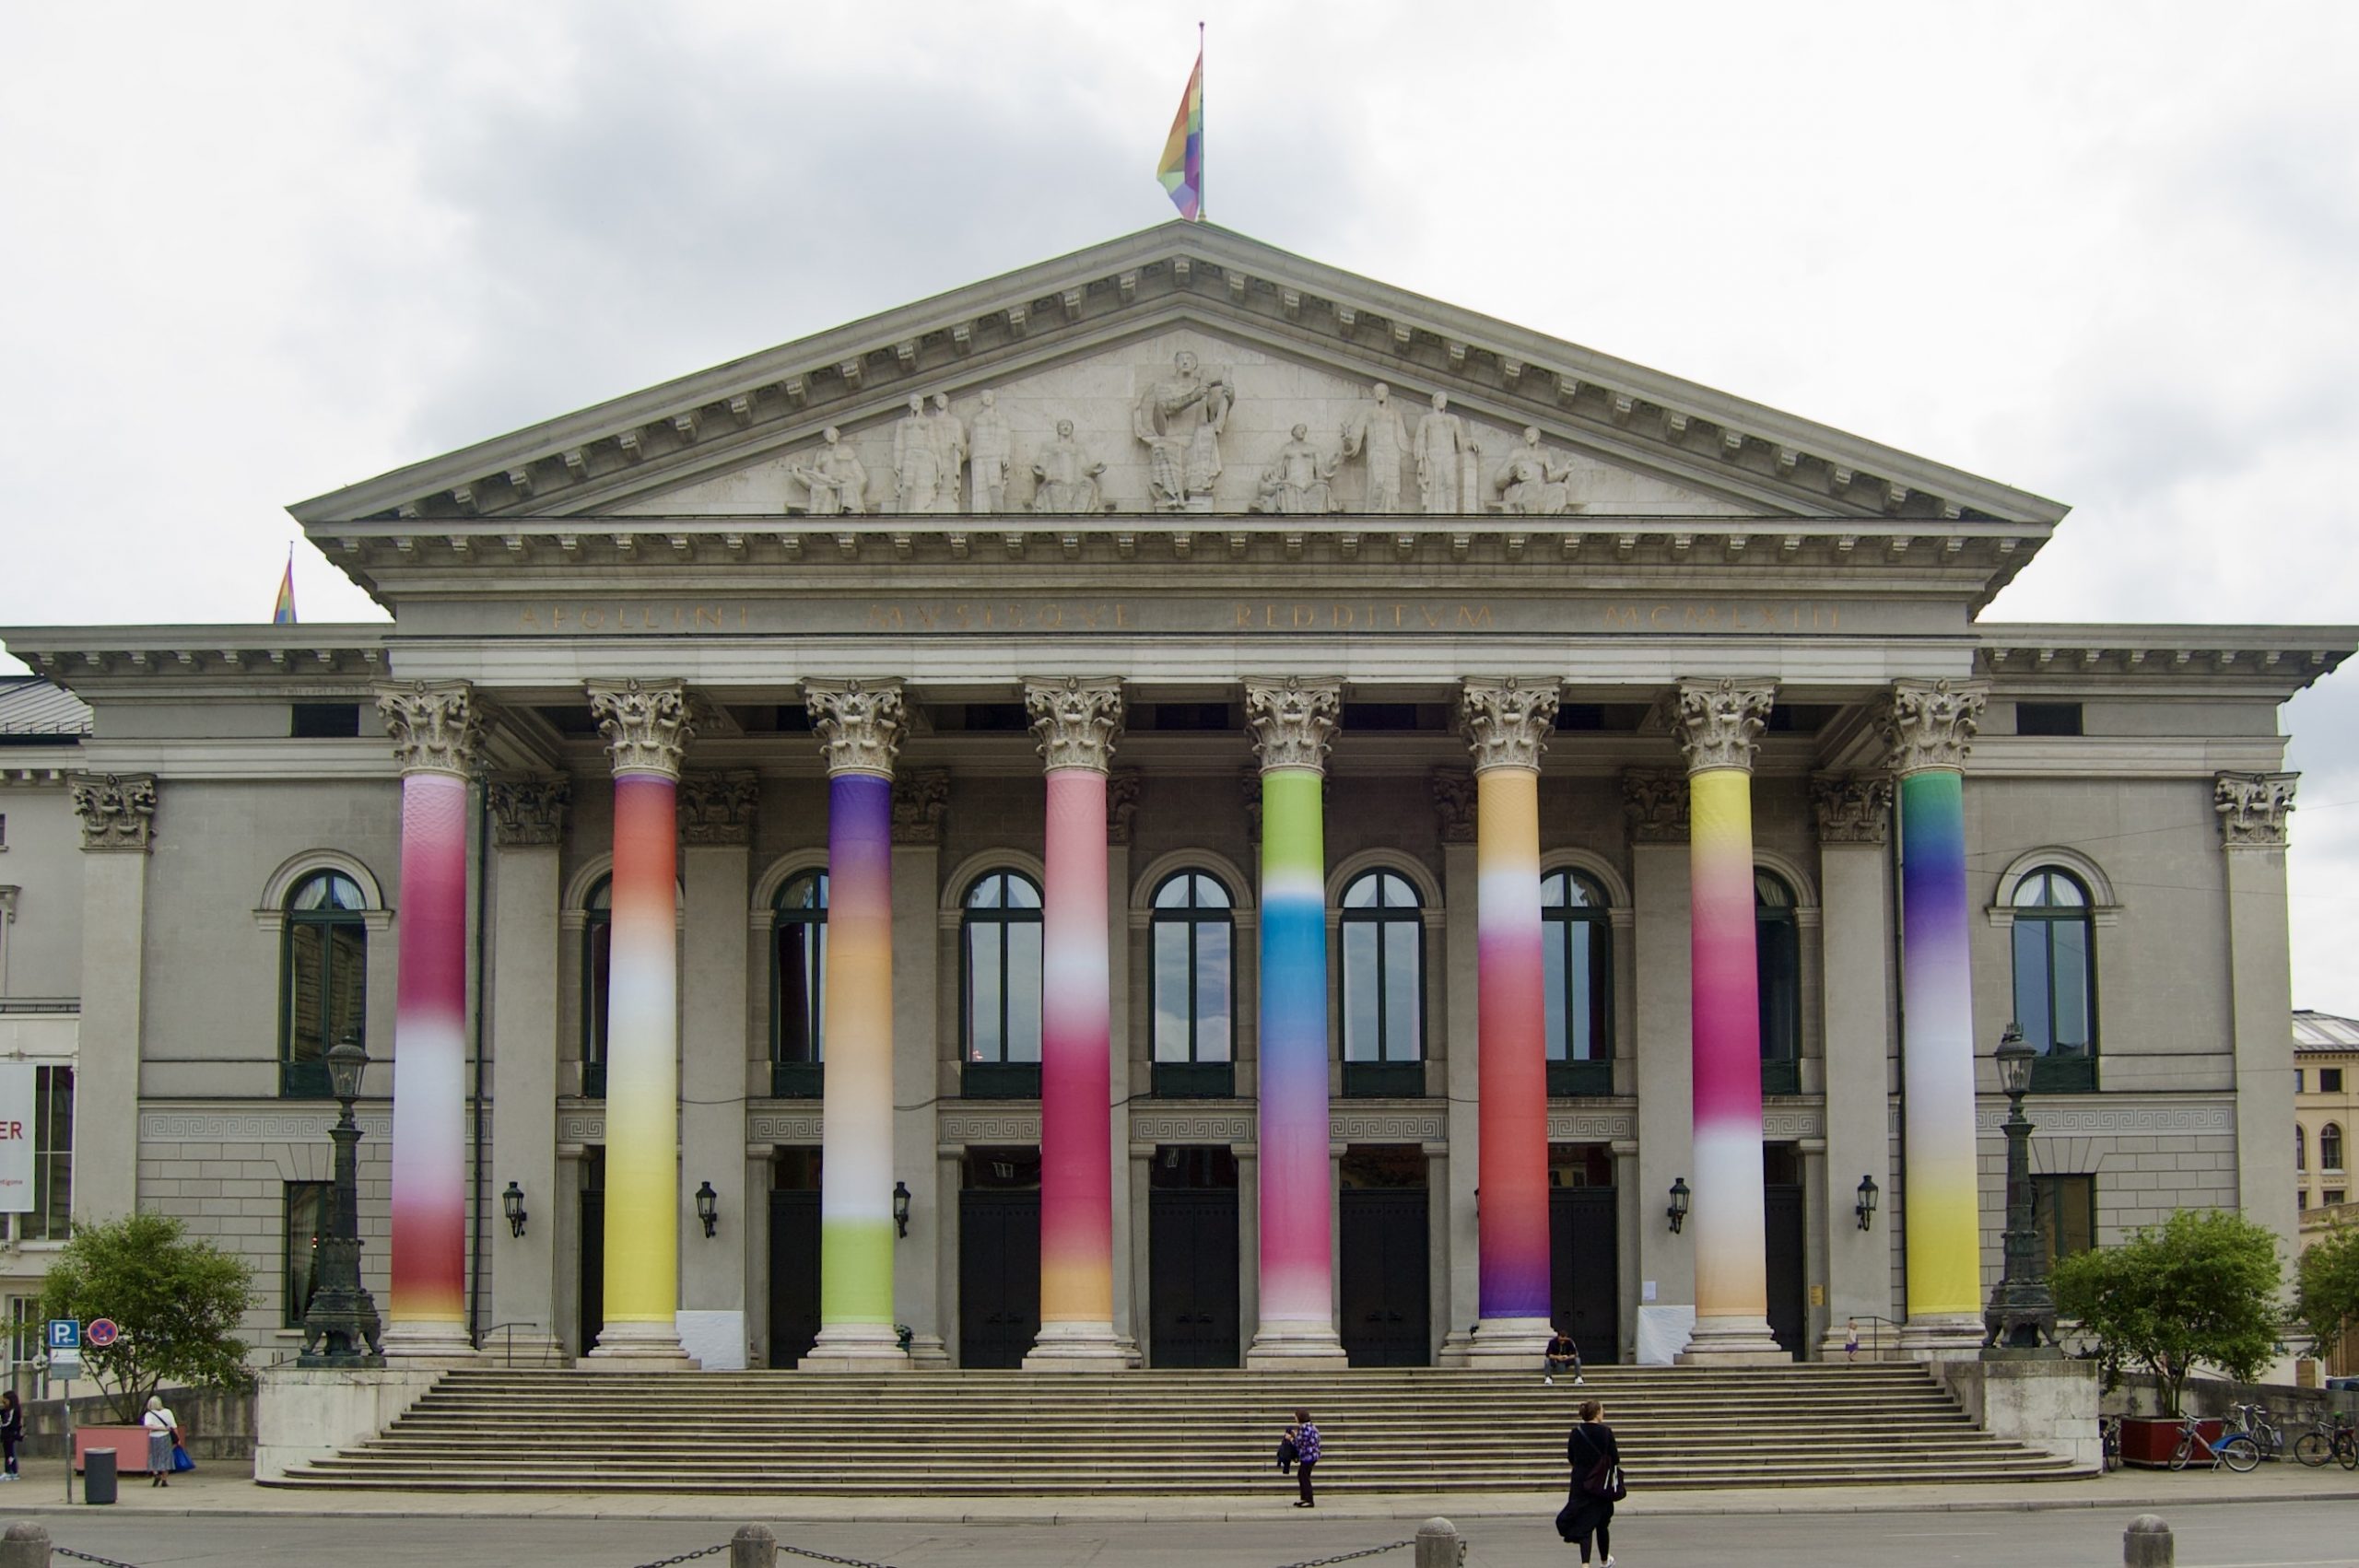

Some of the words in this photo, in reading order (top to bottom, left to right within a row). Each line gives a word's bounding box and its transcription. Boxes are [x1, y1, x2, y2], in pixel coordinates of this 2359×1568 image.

[519, 605, 748, 630] APOLLINI
[1233, 603, 1495, 628] REDDITVM
[1602, 603, 1841, 629] MCMLXIII
[54, 1324, 71, 1343] P
